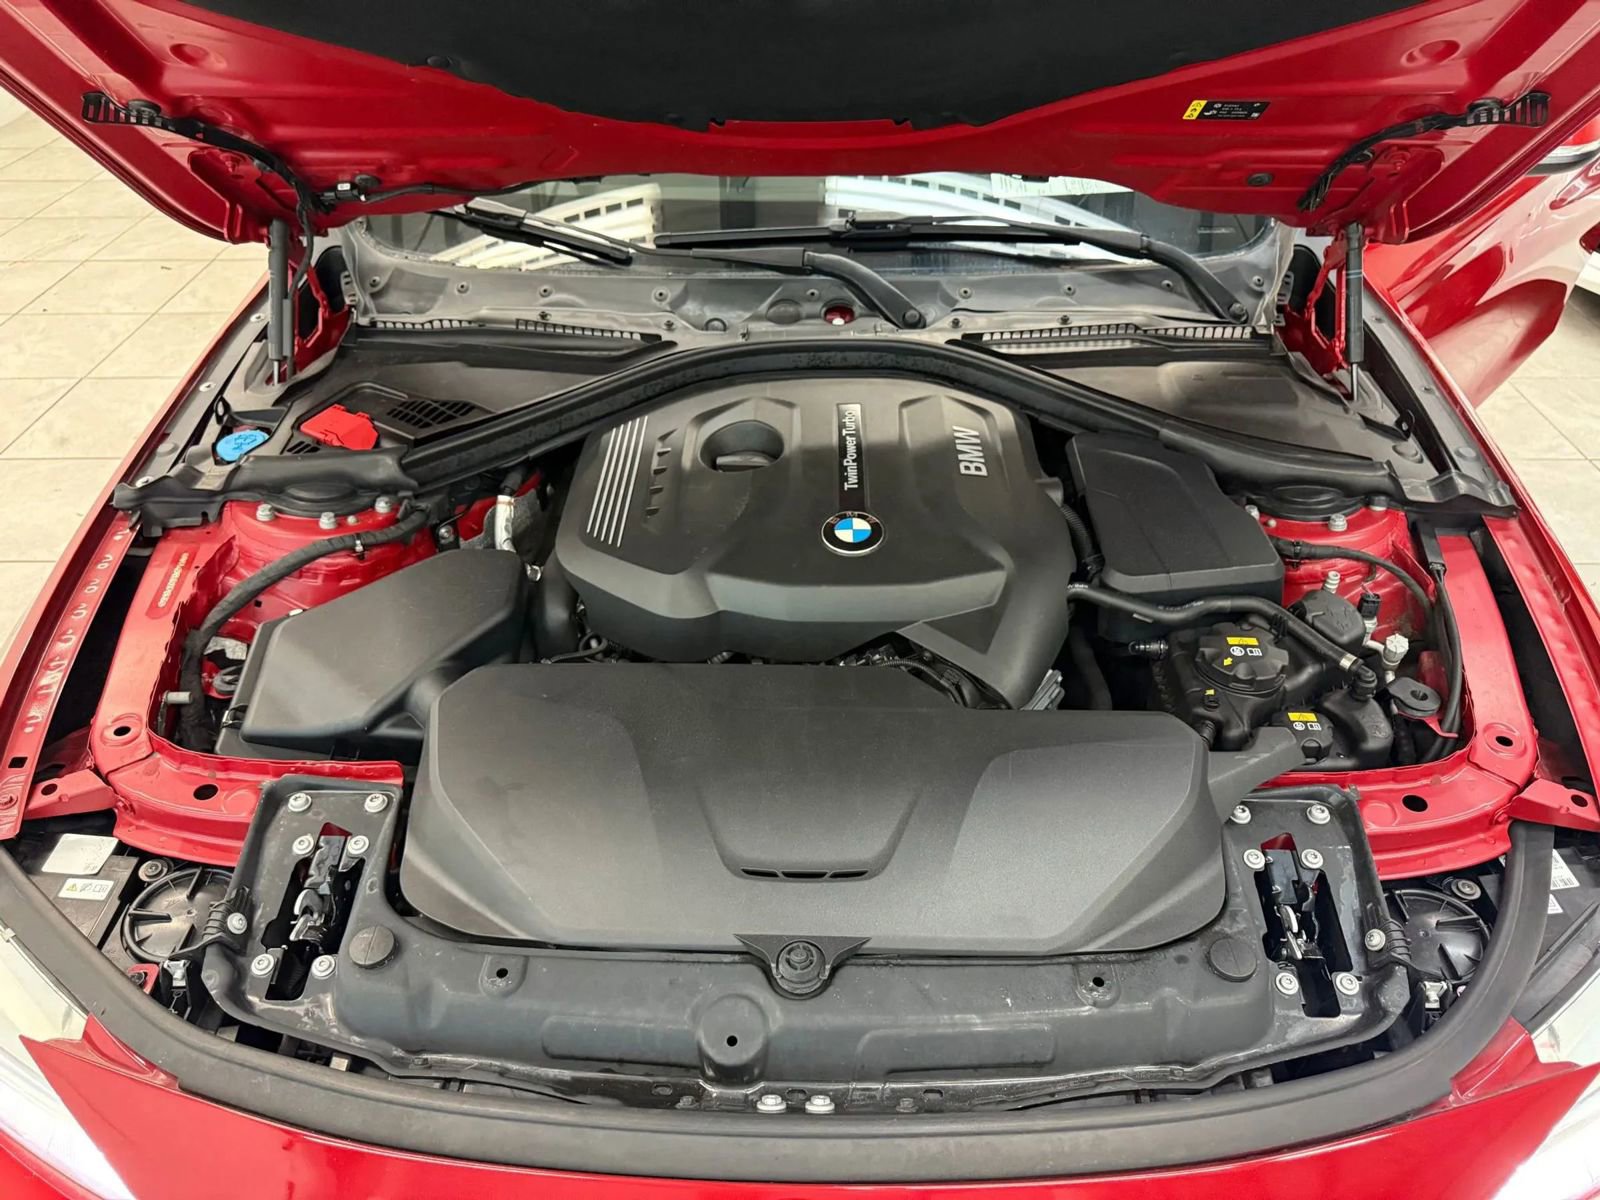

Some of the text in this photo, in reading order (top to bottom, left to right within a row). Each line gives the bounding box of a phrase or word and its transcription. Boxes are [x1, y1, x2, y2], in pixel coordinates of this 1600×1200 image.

[842, 410, 858, 490] TwinPower Turbo
[952, 425, 988, 477] BMW
